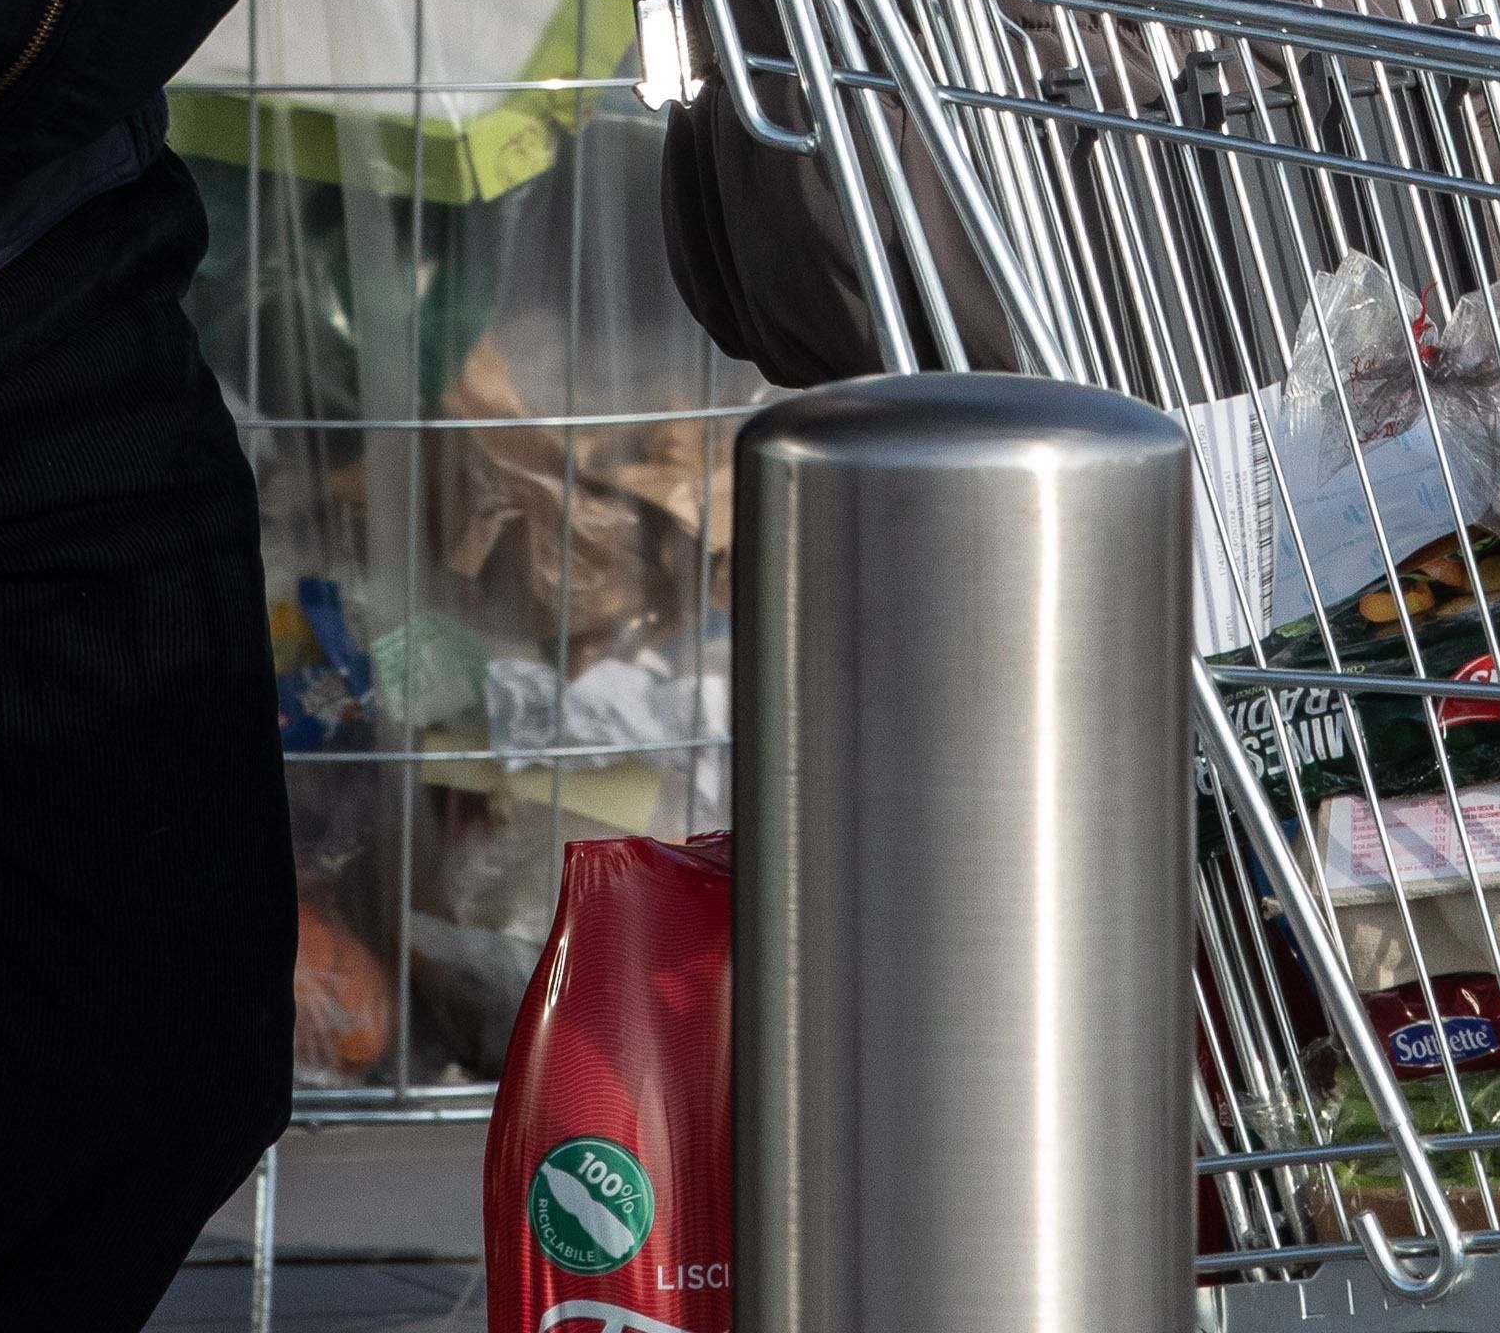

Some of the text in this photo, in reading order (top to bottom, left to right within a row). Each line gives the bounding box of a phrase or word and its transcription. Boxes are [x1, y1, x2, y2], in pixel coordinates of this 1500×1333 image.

[1395, 1026, 1492, 1062] Sottette
[575, 1150, 643, 1215] 100%
[537, 1197, 597, 1263] RICICLABILE
[656, 1262, 730, 1291] LISCI
